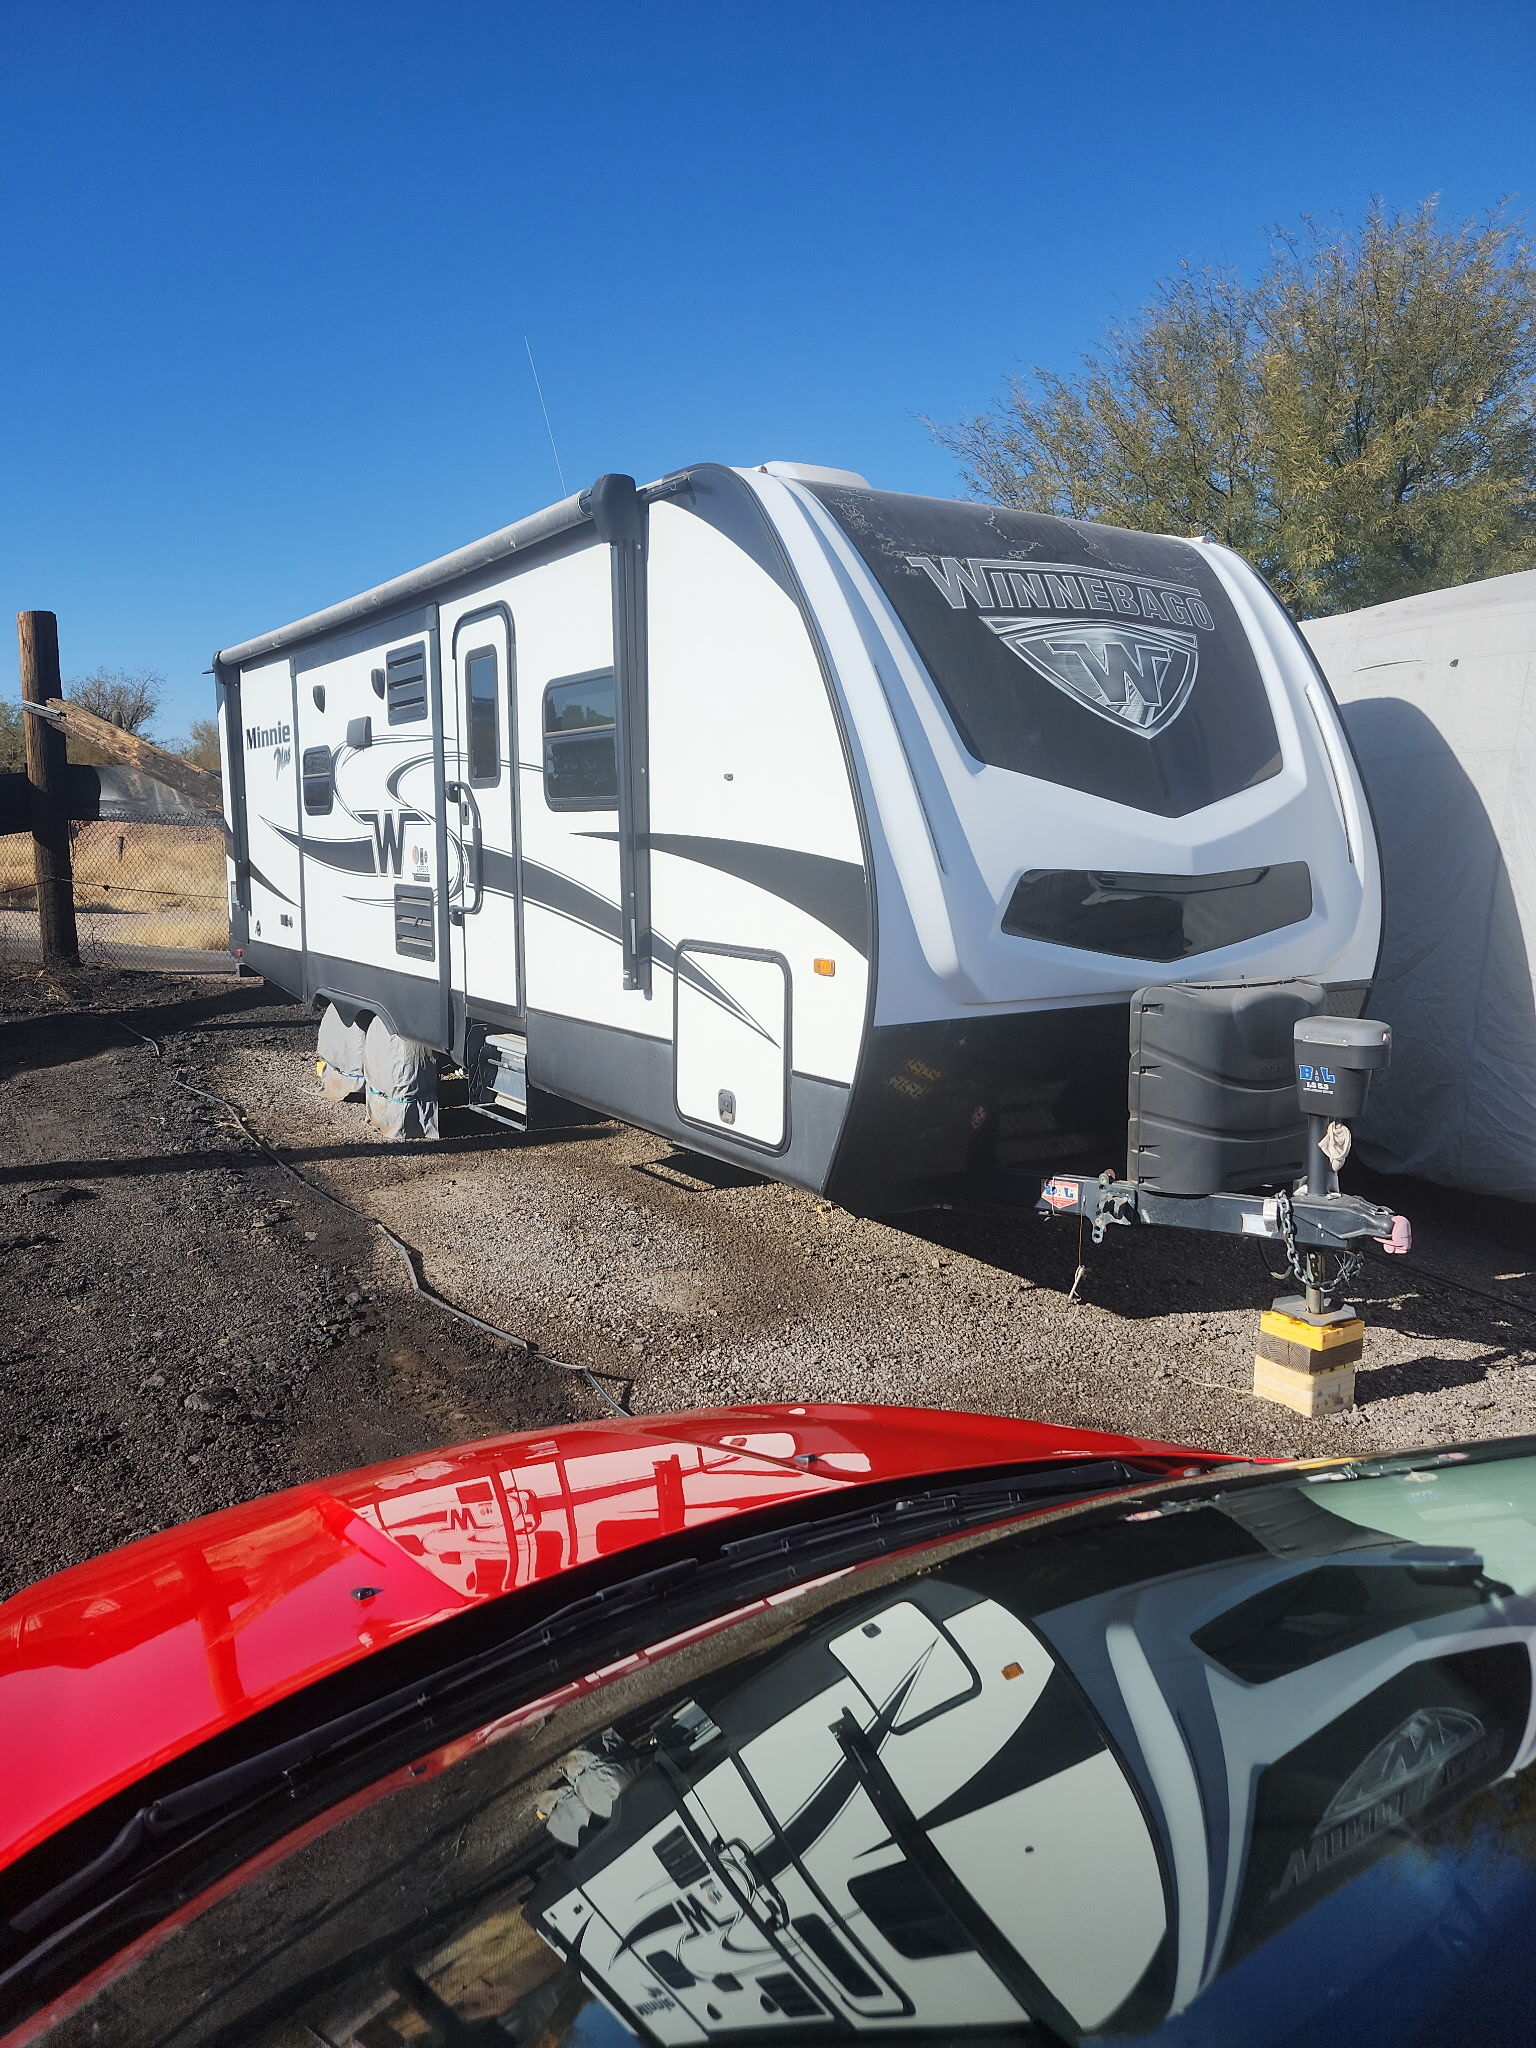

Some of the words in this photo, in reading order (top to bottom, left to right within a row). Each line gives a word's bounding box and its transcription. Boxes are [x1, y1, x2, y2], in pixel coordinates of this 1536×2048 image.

[906, 557, 1215, 631] WINNEBAGO
[1043, 640, 1172, 707] W
[246, 720, 291, 750] Minnie
[352, 808, 431, 878] W
